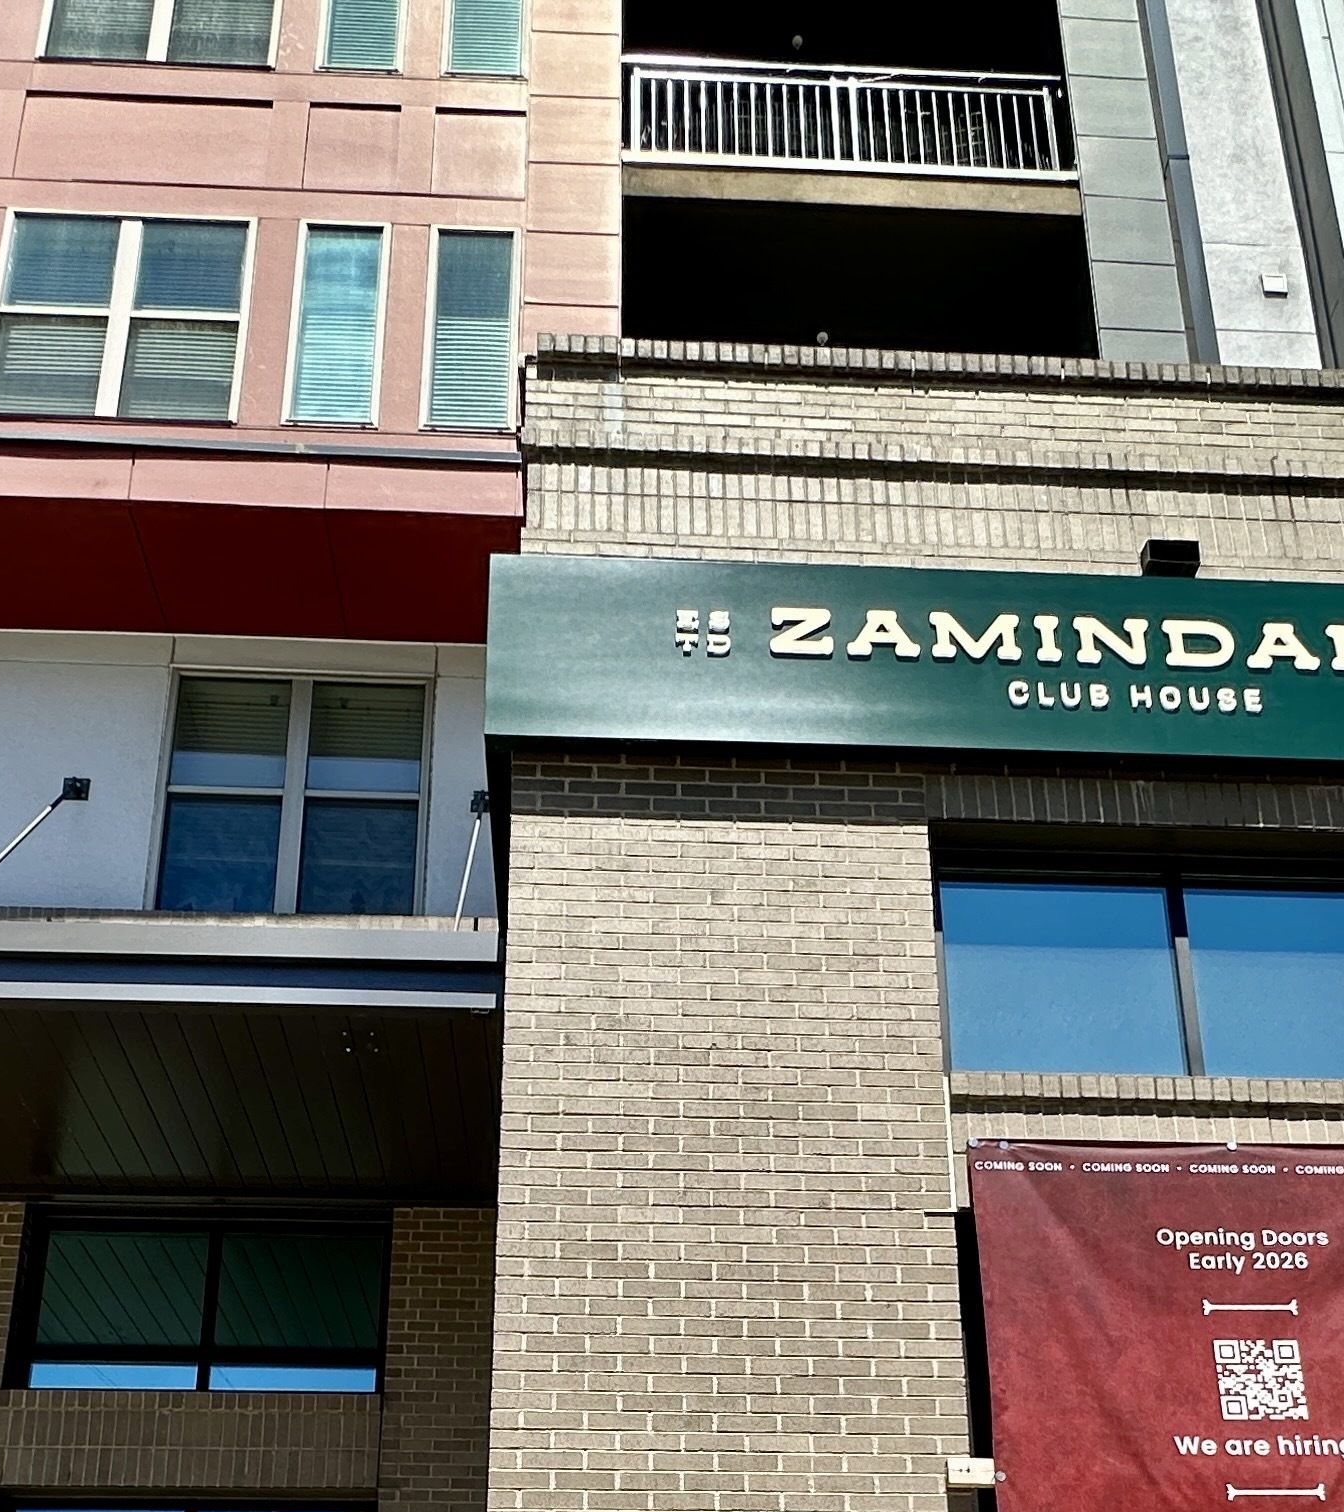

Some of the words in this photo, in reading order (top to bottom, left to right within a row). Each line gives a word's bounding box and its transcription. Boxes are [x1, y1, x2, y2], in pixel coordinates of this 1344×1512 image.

[675, 632, 732, 656] TD
[1008, 680, 1110, 707] CLUB
[1130, 685, 1263, 712] HOUSE
[974, 1160, 1025, 1171] COMING
[1028, 1161, 1063, 1171] SOON
[1082, 1162, 1133, 1173] COMING
[1135, 1163, 1170, 1173] SOON
[1189, 1164, 1239, 1174] COMING
[1242, 1164, 1276, 1174] SOON
[1295, 1165, 1344, 1175] COMING
[1156, 1227, 1256, 1251] Opening
[1261, 1229, 1329, 1246] Doors
[1189, 1252, 1246, 1275] Early
[1252, 1251, 1309, 1269] 2026
[1173, 1436, 1218, 1456] We
[1224, 1439, 1271, 1456] are
